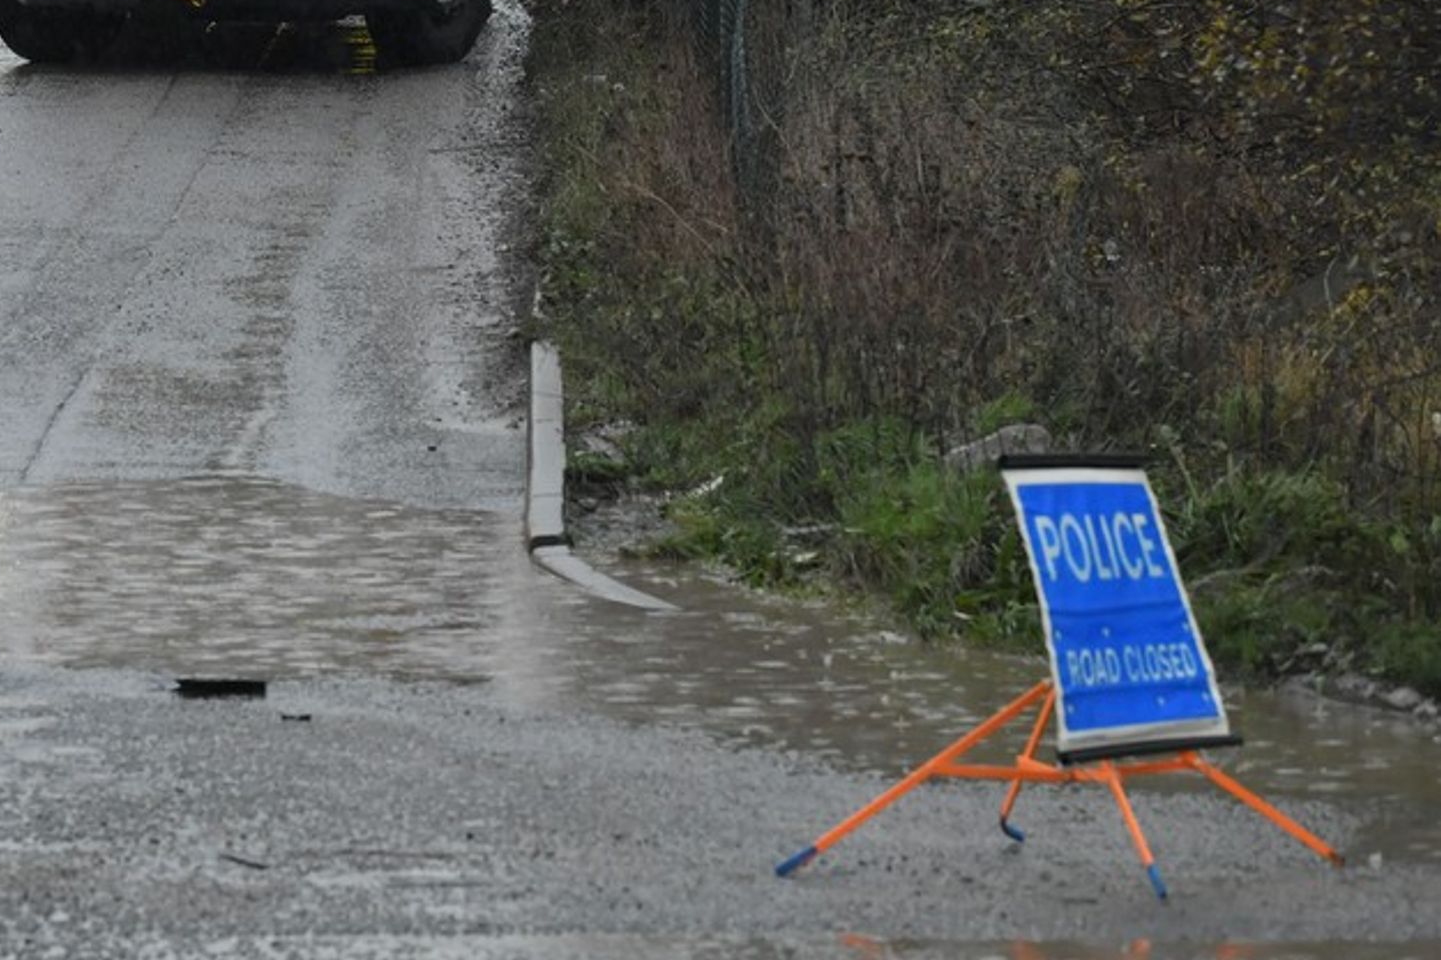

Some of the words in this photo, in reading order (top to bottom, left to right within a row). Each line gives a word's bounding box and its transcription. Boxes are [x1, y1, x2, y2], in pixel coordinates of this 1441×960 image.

[1034, 512, 1165, 583] POLICE
[1066, 646, 1122, 687] ROAD
[1122, 642, 1197, 681] CLOSED
